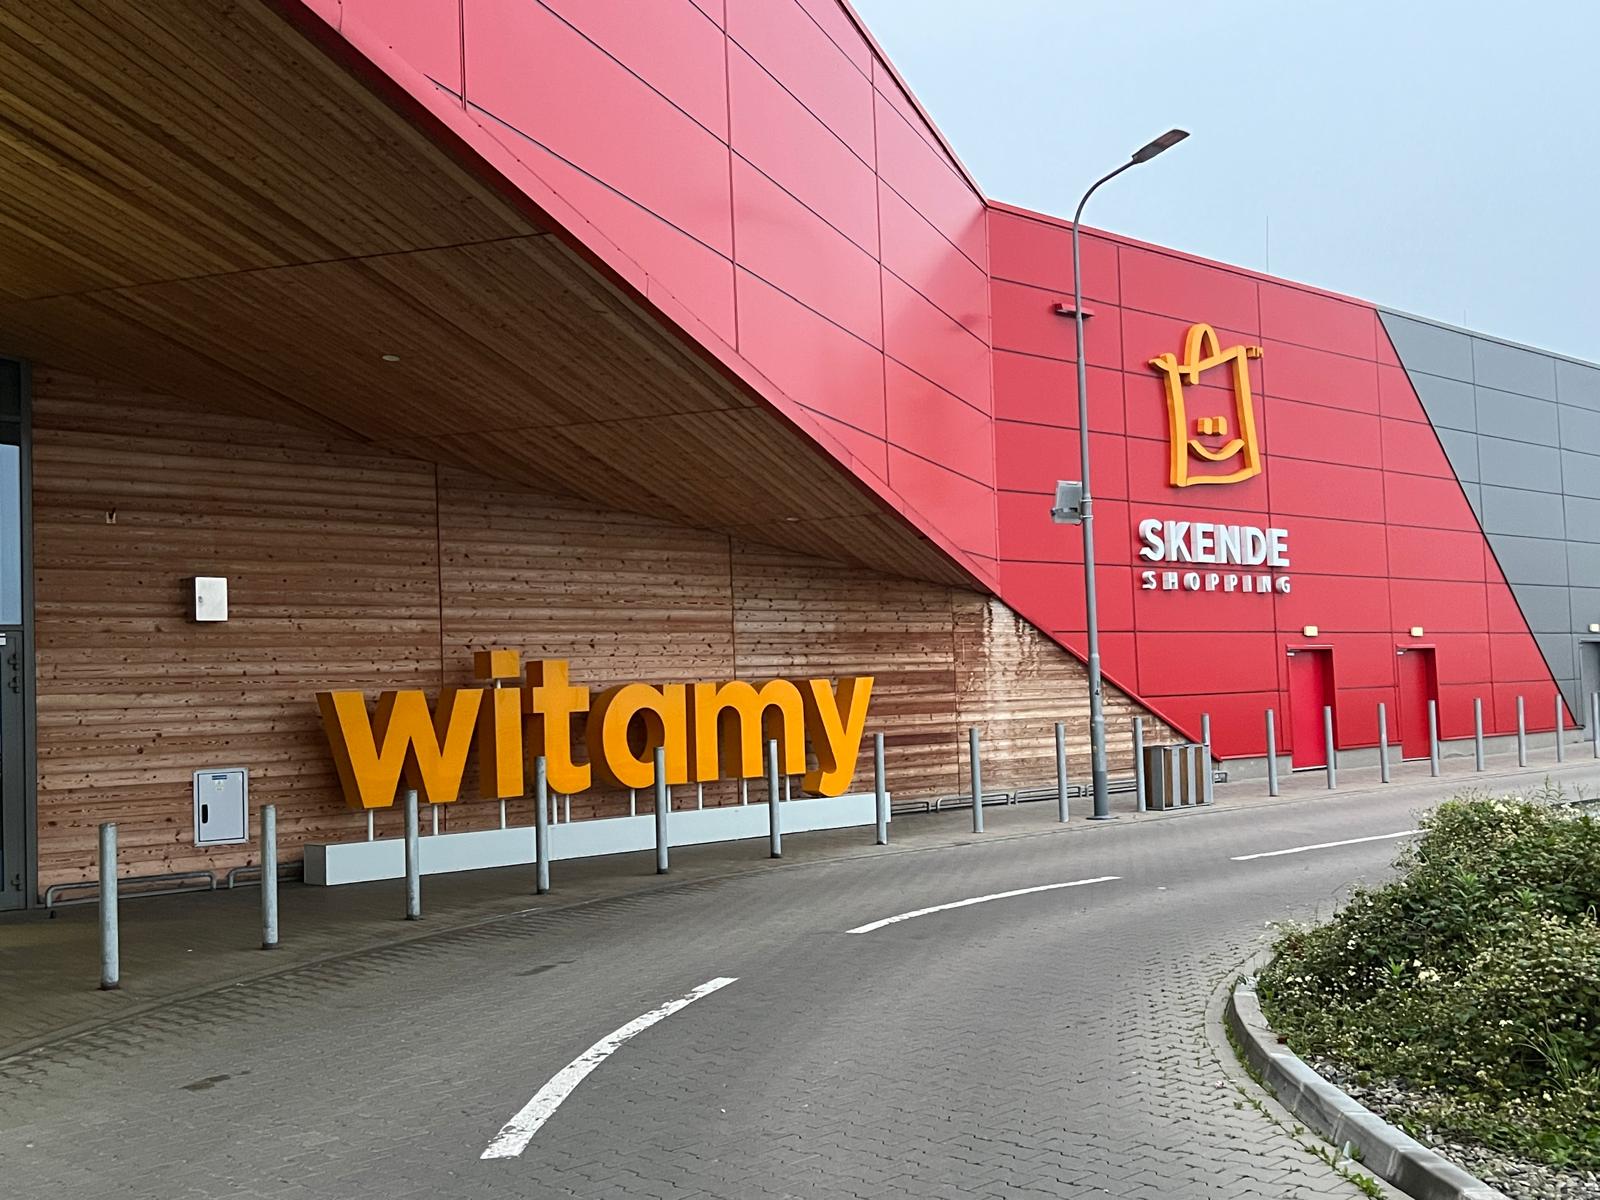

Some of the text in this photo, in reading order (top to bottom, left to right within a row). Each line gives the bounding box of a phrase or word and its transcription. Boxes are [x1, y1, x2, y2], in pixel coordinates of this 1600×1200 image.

[1138, 518, 1290, 567] SKENDE
[1141, 570, 1291, 594] SHOPPING
[316, 650, 874, 808] witamy
